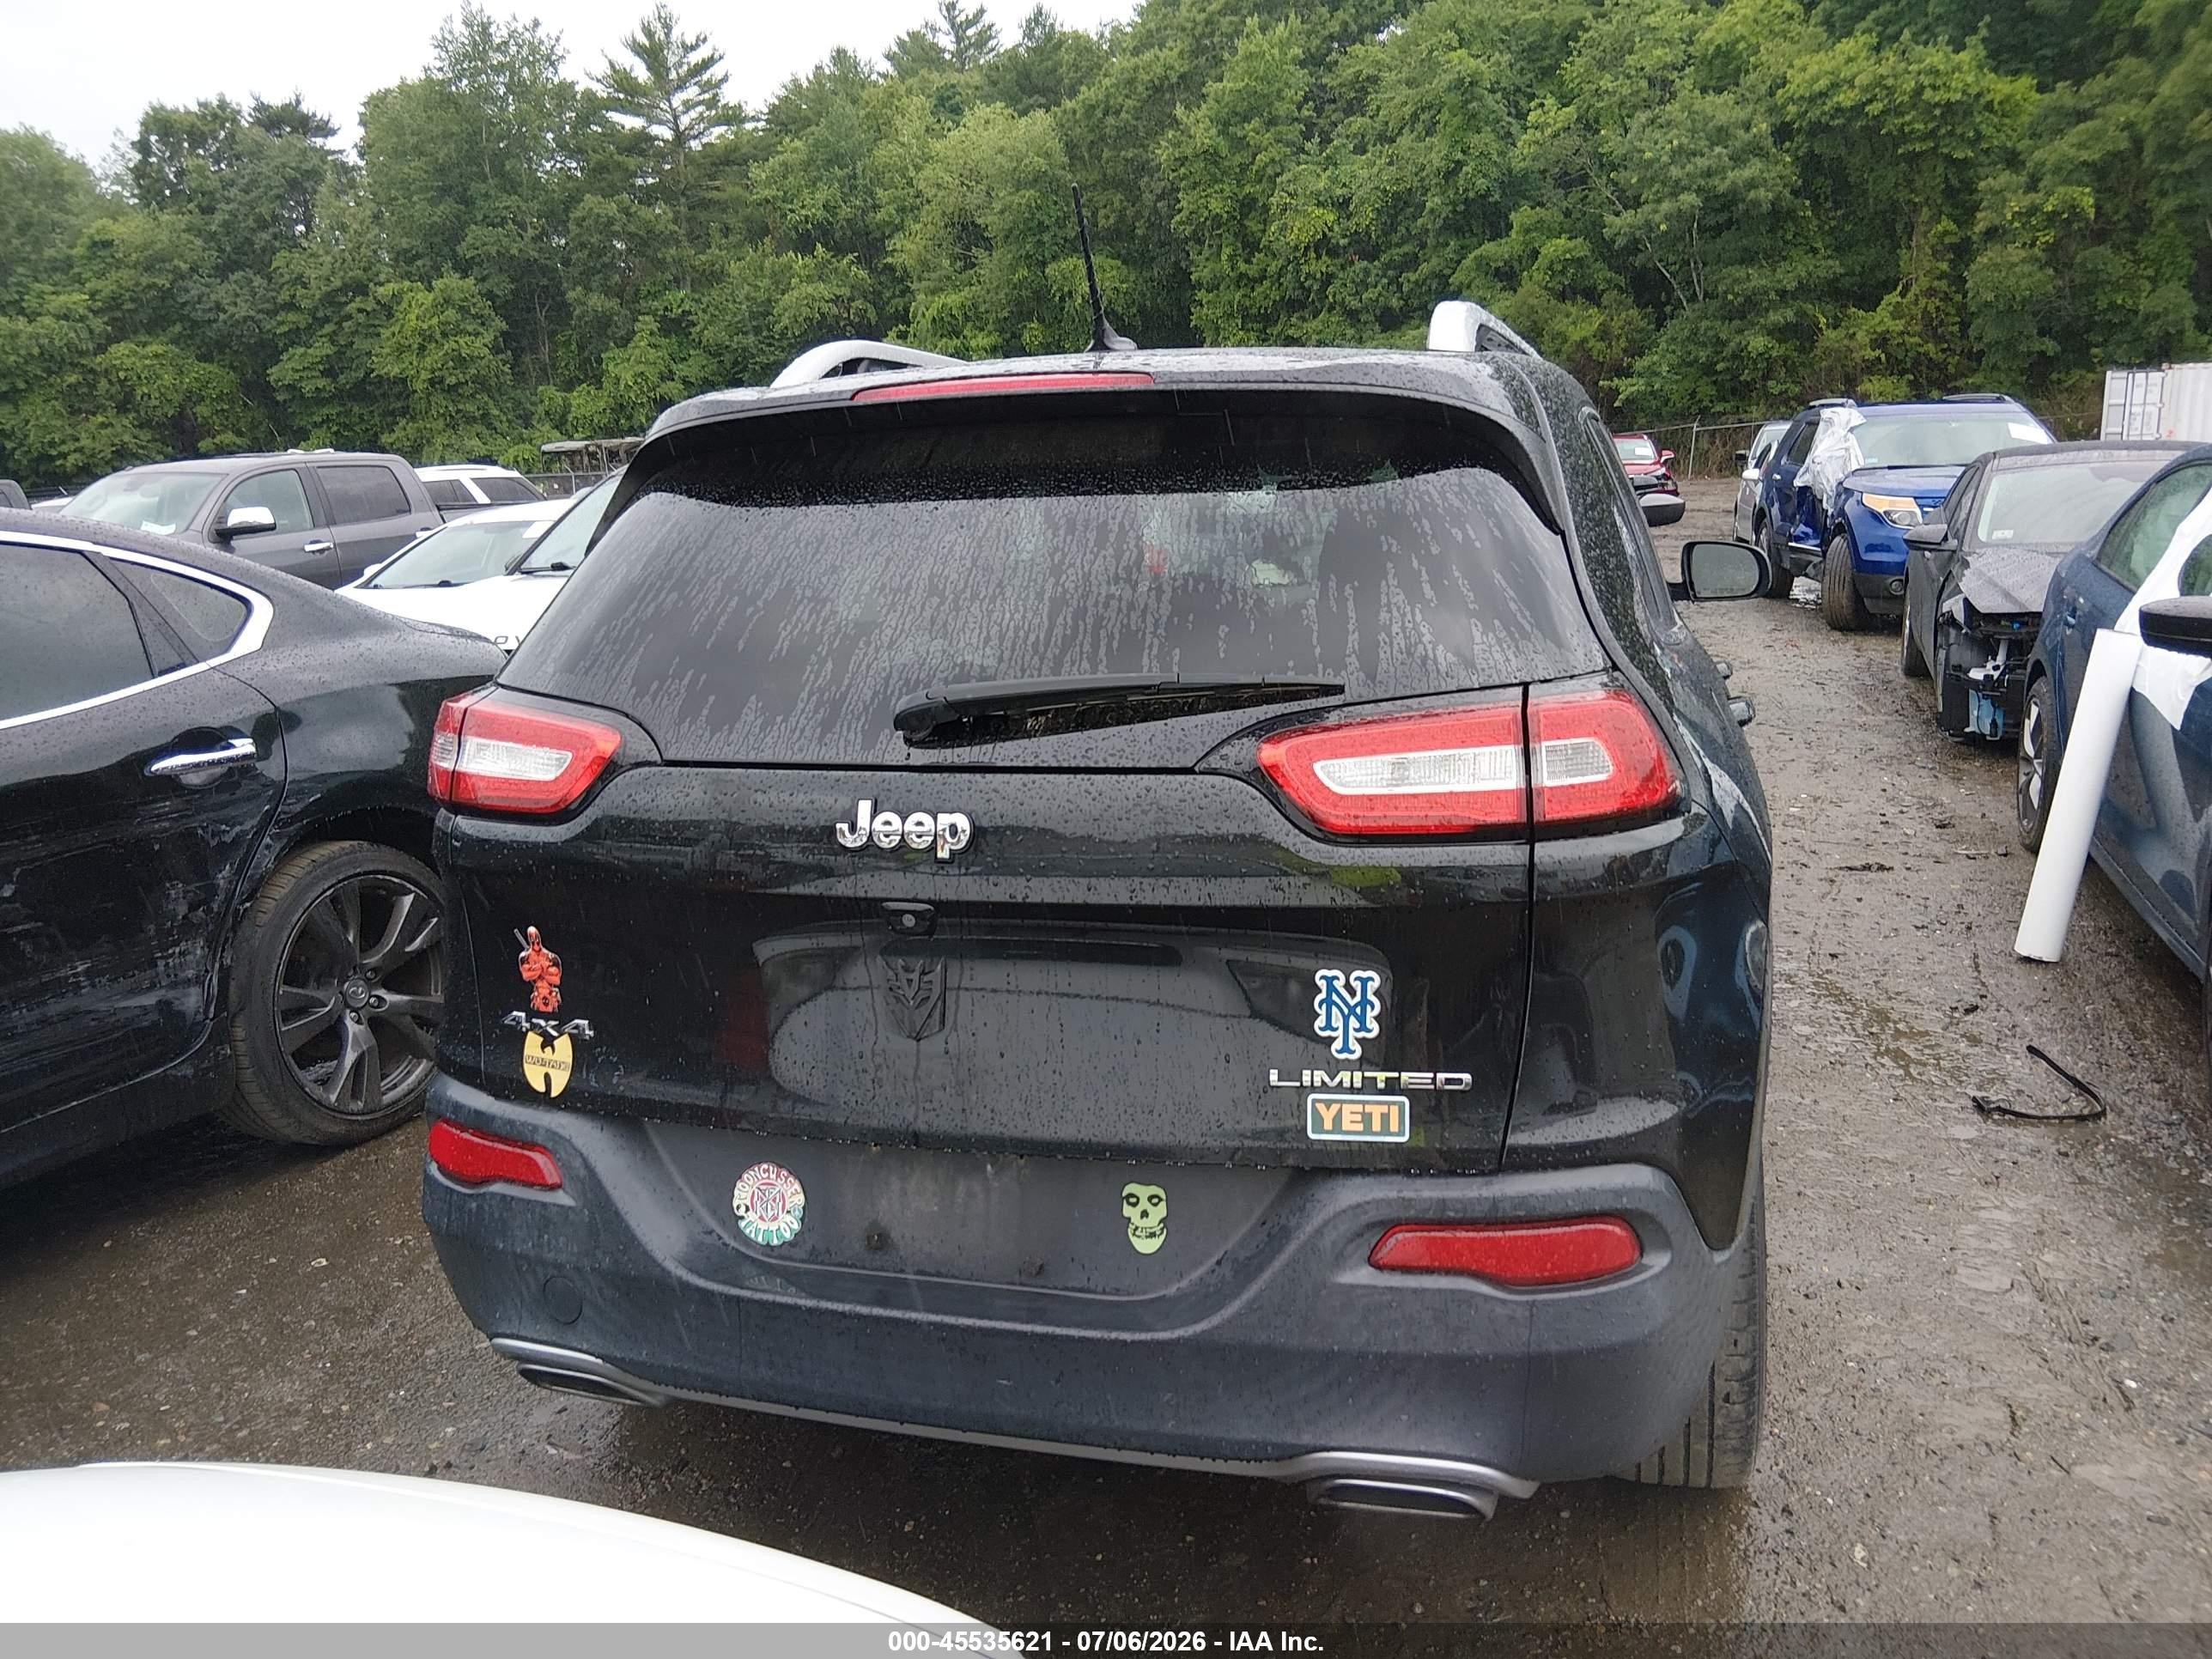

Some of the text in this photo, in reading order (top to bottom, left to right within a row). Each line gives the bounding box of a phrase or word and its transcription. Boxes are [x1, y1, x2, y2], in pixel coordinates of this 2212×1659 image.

[835, 799, 971, 860] Jeep
[1268, 1068, 1474, 1091] LIMITED
[1315, 1102, 1400, 1133] YETI
